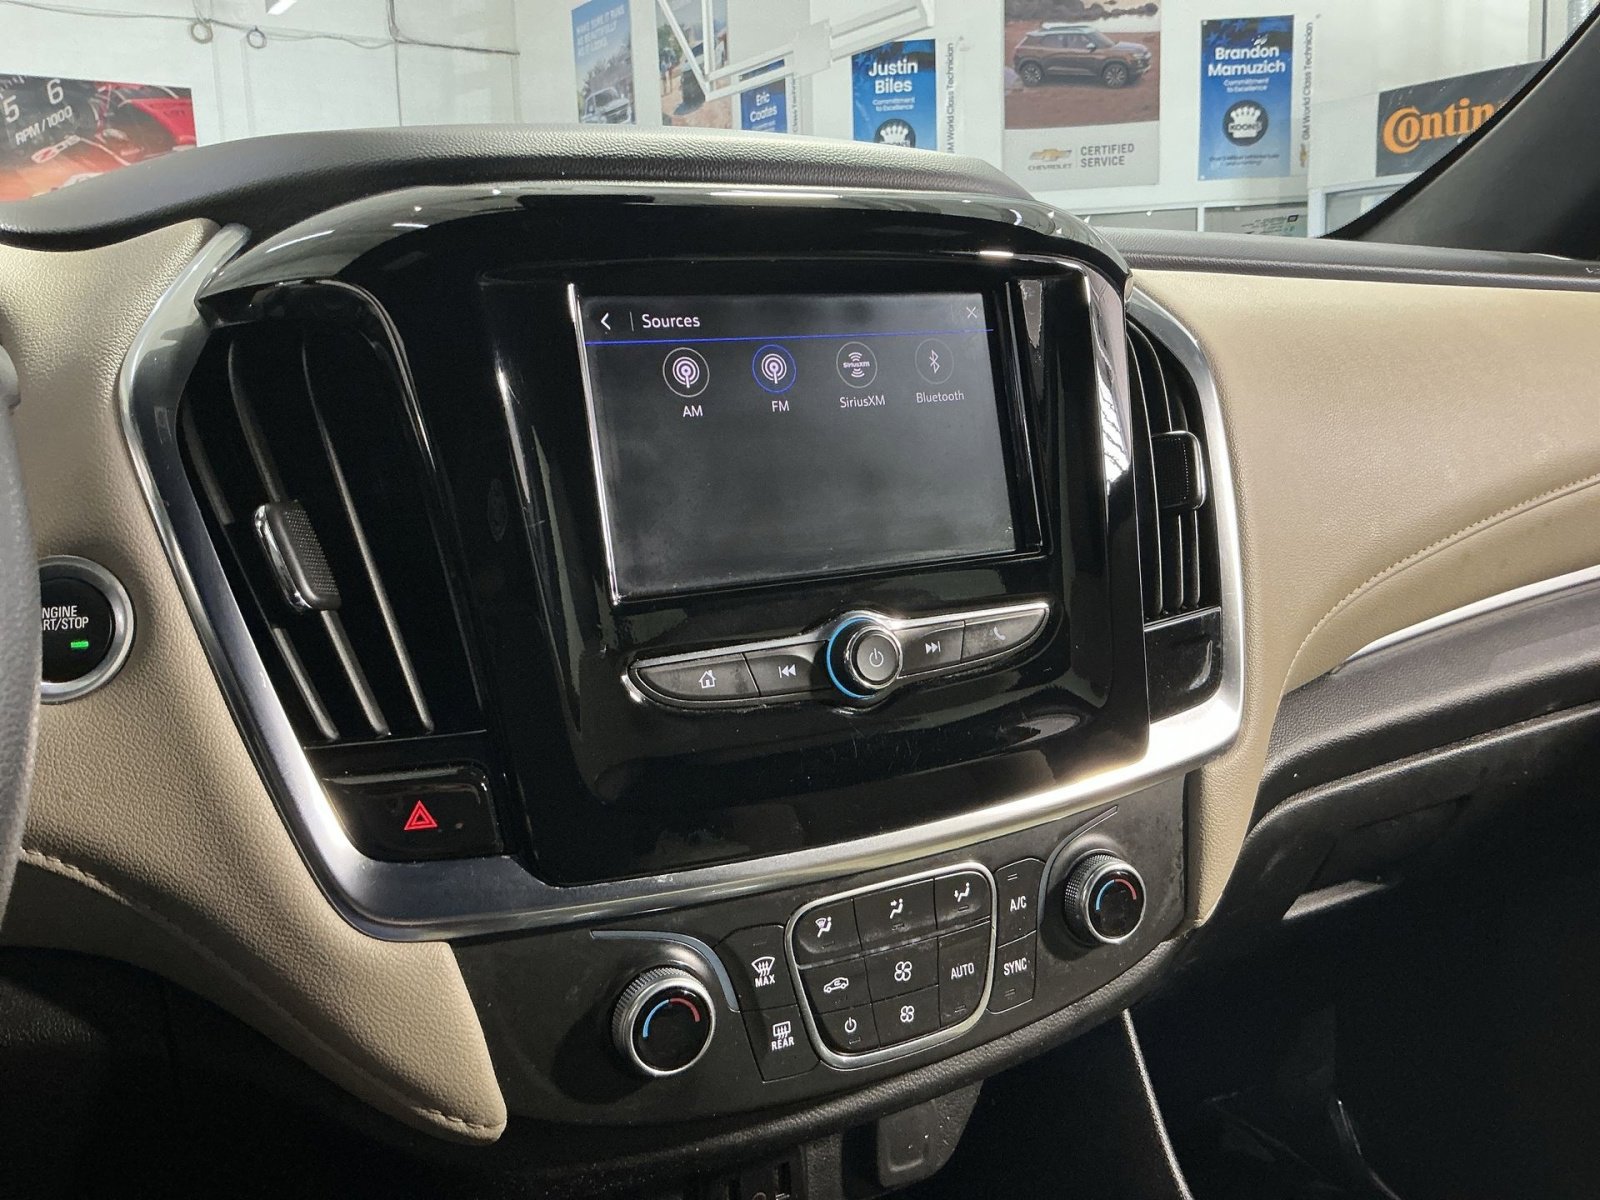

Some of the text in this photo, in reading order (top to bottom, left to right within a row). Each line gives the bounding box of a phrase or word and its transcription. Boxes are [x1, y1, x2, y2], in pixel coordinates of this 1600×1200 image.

[1215, 44, 1280, 60] Brandon
[1304, 22, 1314, 69] Technician
[868, 58, 918, 77] Justin
[946, 43, 955, 89] Technician
[1208, 60, 1286, 76] Mamuzich
[46, 78, 64, 105] 6
[875, 78, 913, 94] Biles
[1303, 72, 1312, 96] Class
[756, 91, 770, 106] Eric
[946, 91, 955, 115] Class
[3, 94, 20, 123] 5
[1303, 97, 1311, 124] World
[946, 116, 955, 141] World
[1383, 97, 1502, 154] Contin
[1080, 143, 1135, 156] CERTIFIED
[1028, 163, 1073, 171] CHEVROLET
[1080, 155, 1125, 168] SERVICE
[641, 313, 701, 329] Sources
[839, 394, 886, 409] SiriusXM
[916, 389, 965, 404] Bluetooth
[682, 405, 704, 418] AM
[772, 400, 790, 413] FM
[42, 605, 78, 618] NGINE
[42, 616, 89, 631] RT/STOP
[1009, 895, 1027, 912] A/C
[951, 962, 975, 980] AUTO
[1003, 957, 1028, 976] SYNC
[755, 974, 776, 988] MAX
[771, 1036, 795, 1051] REAR
